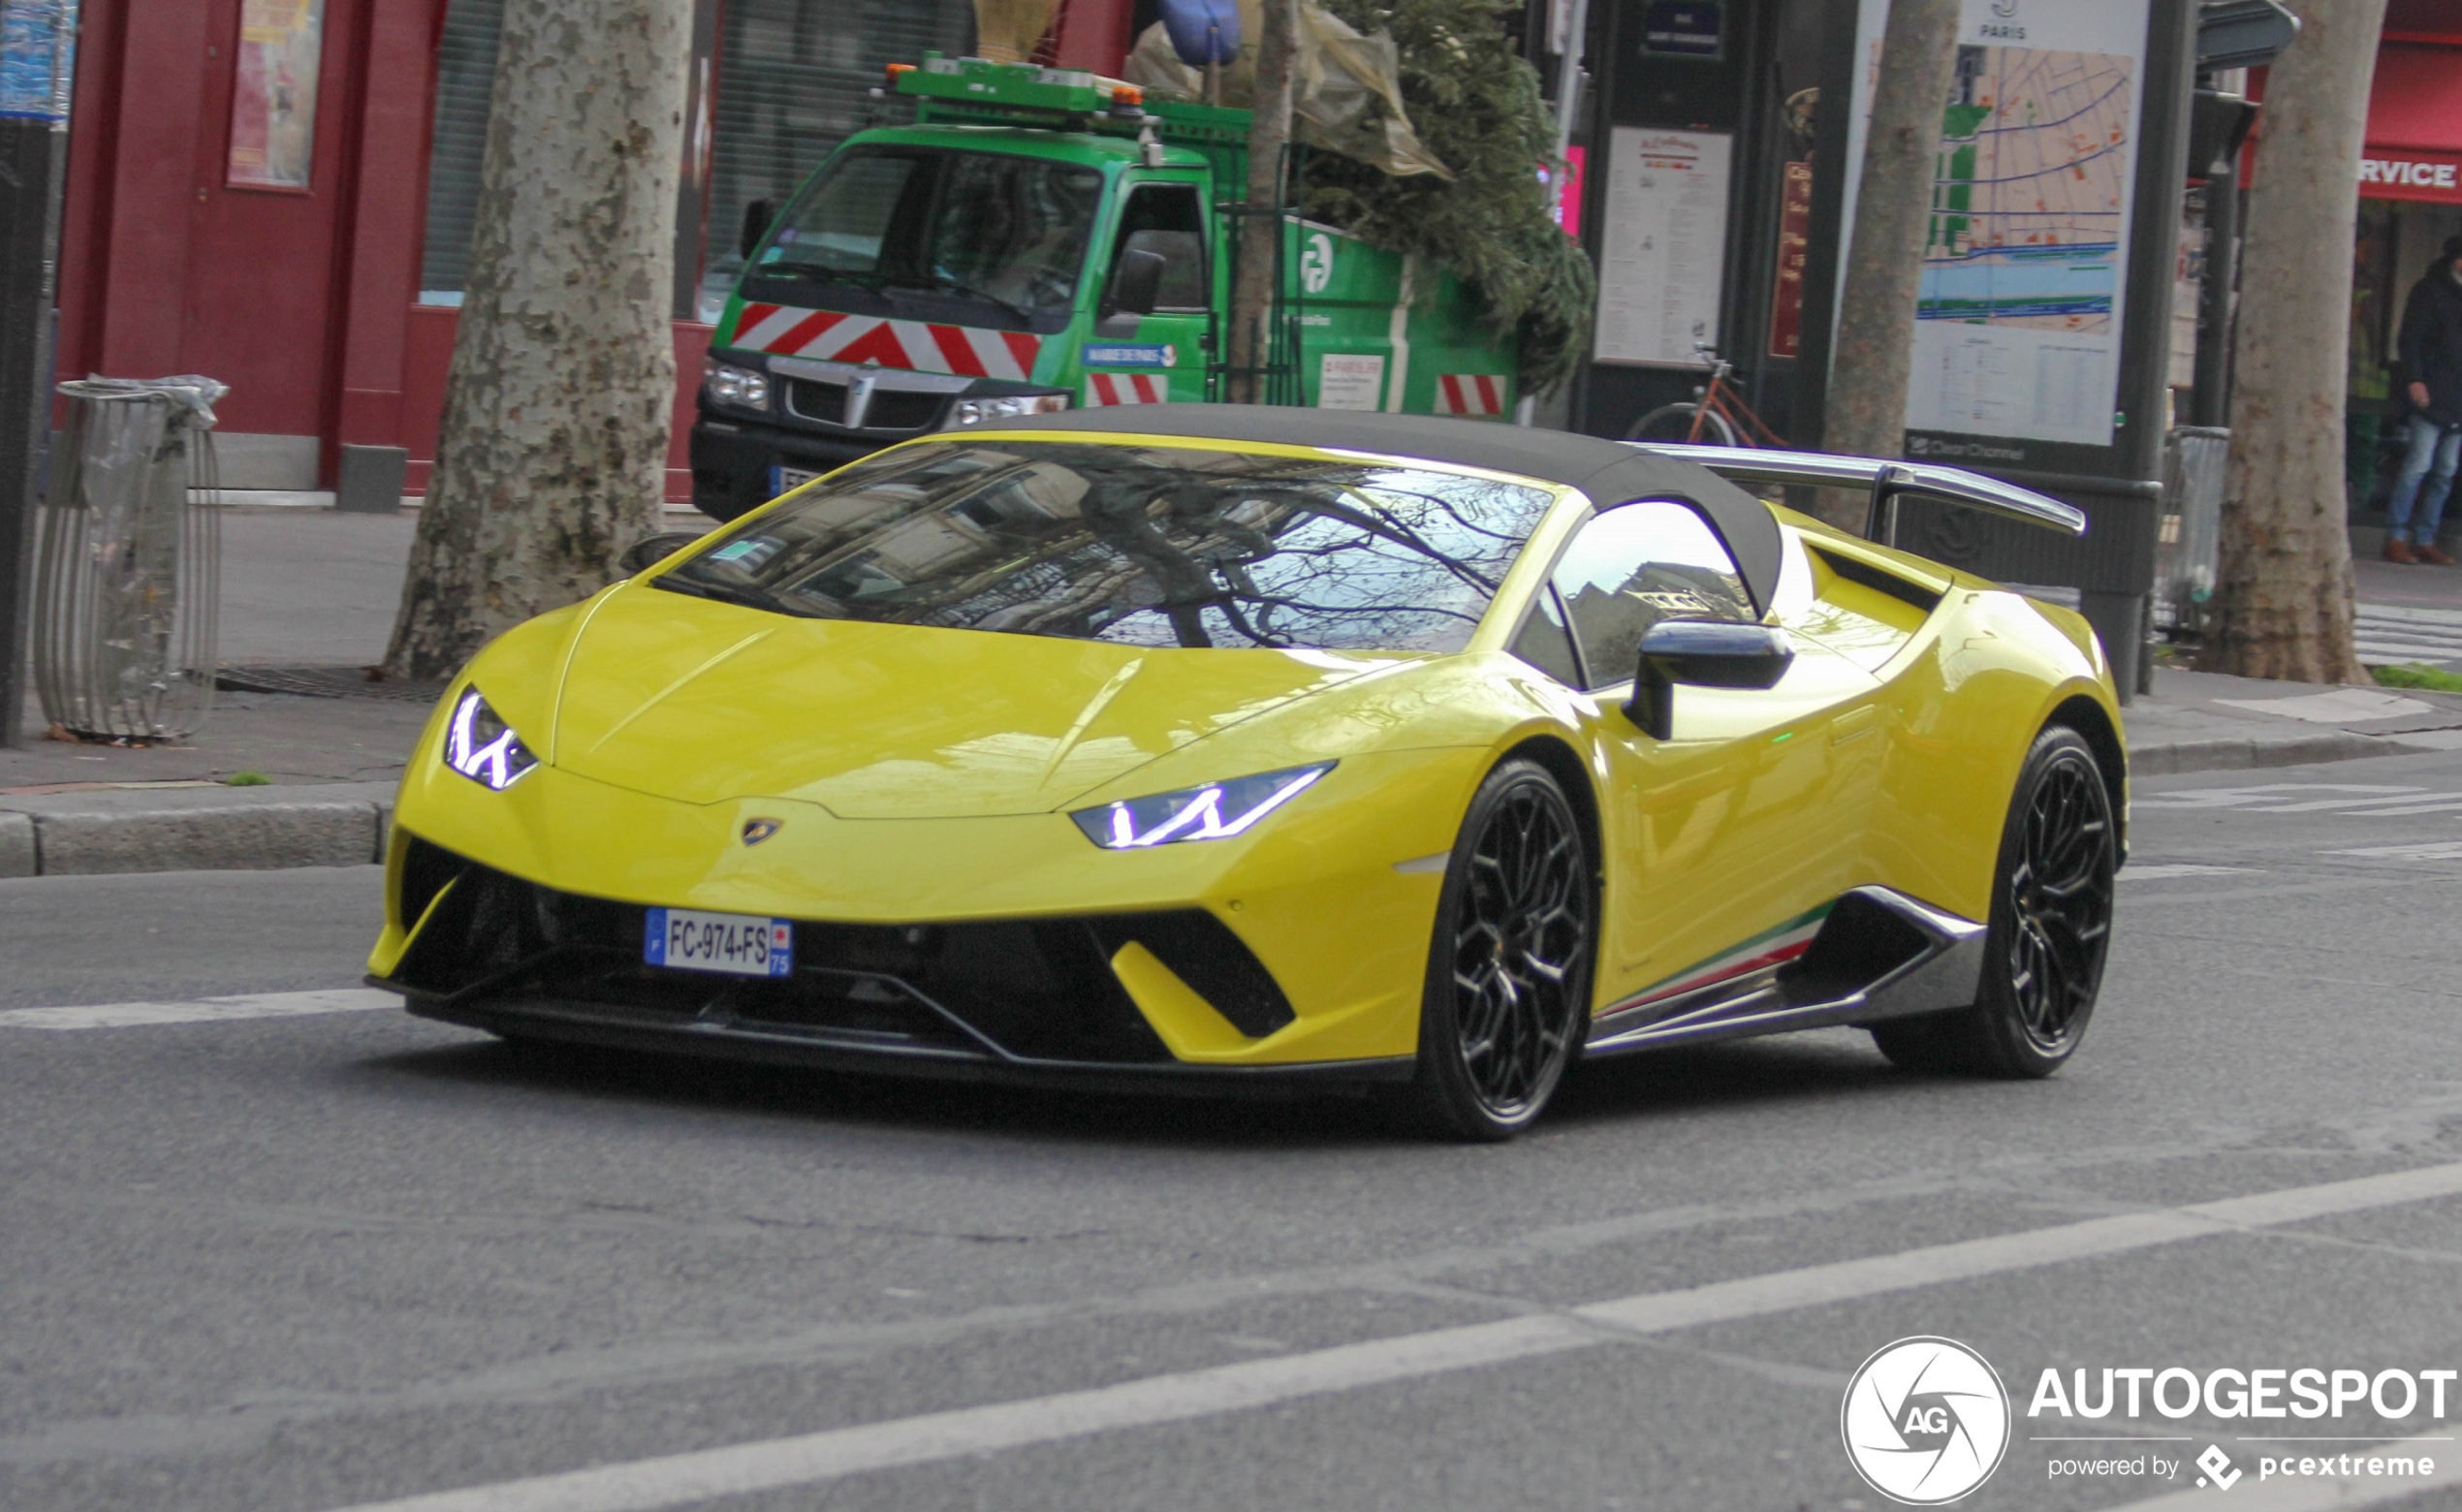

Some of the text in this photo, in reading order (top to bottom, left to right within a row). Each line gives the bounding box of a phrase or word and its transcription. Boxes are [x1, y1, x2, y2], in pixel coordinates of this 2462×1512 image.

[1979, 24, 2027, 40] PARIS
[1929, 440, 2026, 460] Clear Channel
[670, 919, 769, 964] FC-974-FS
[771, 955, 790, 974] 75
